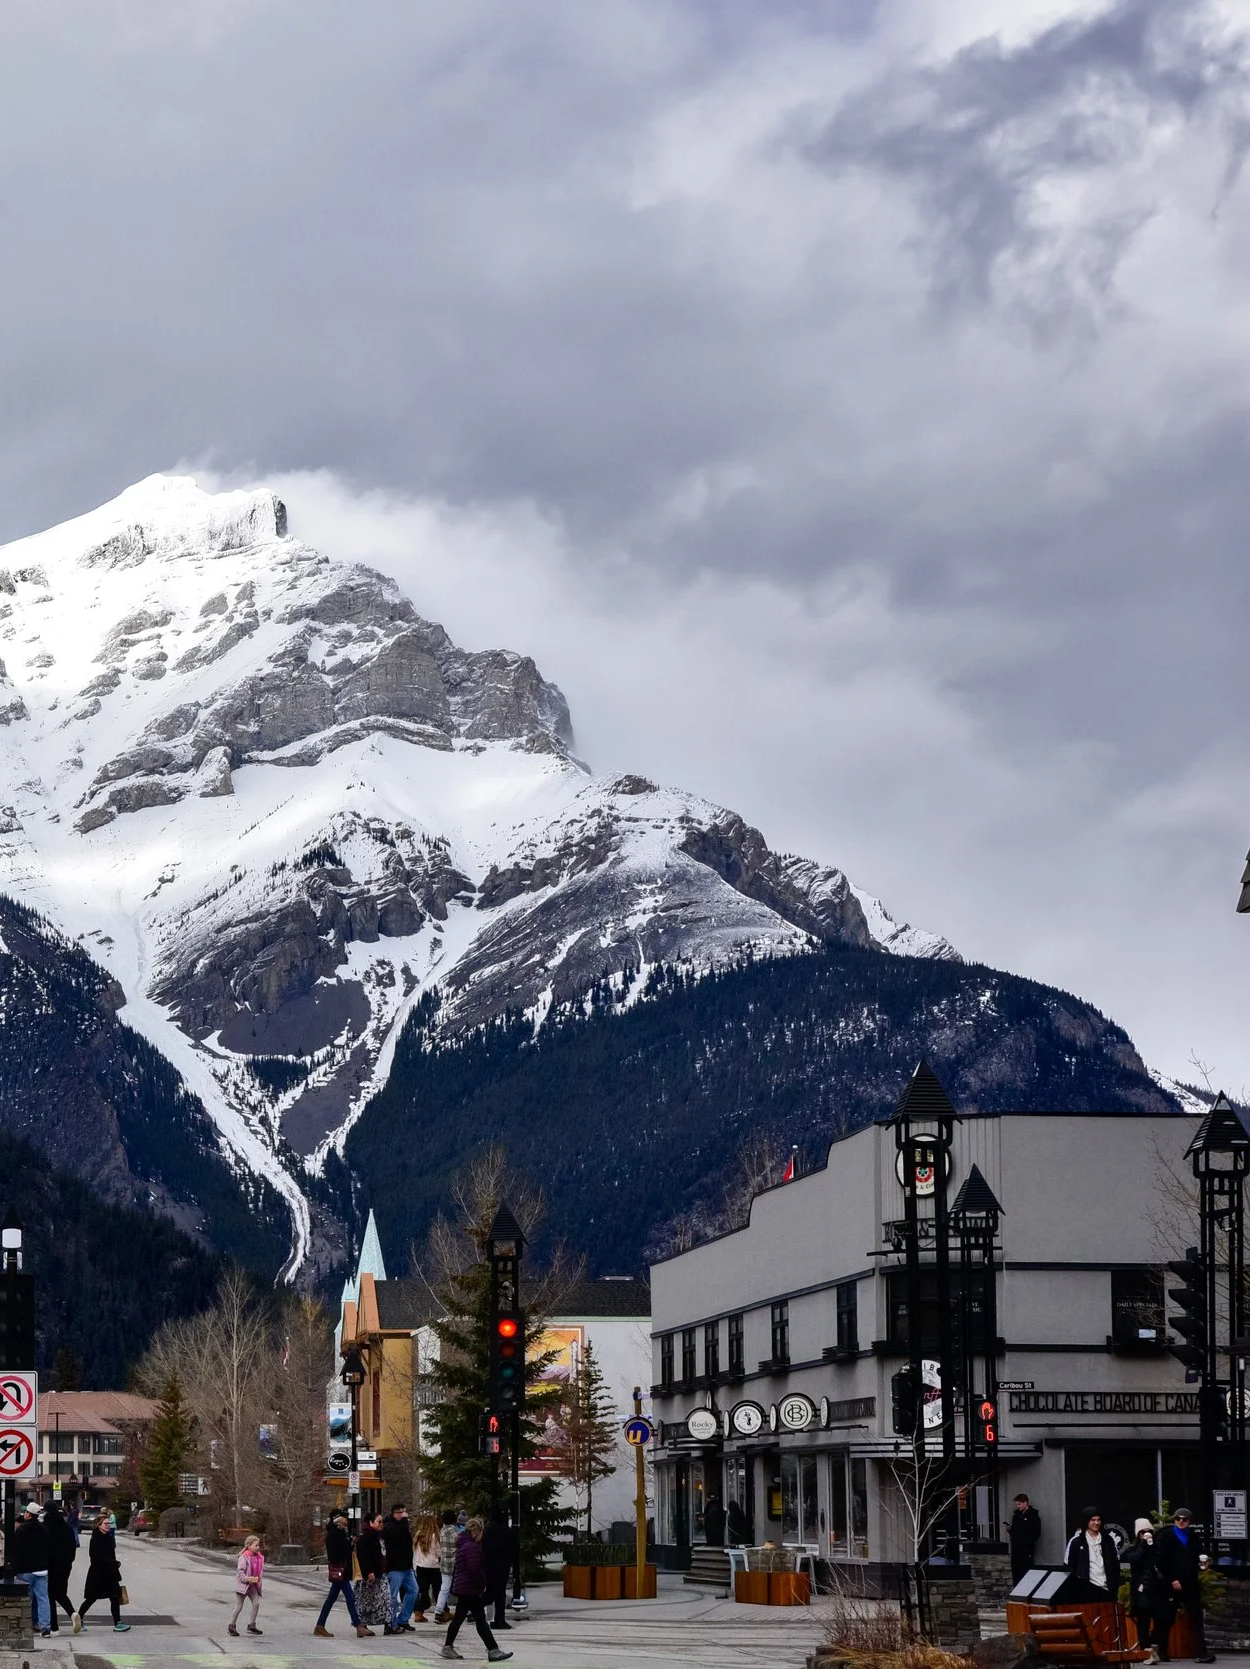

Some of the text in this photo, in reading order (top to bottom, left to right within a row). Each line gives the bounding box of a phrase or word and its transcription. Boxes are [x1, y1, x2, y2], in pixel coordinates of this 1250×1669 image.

[1010, 1392, 1201, 1412] CHOCOLATE BOARD OF CANA
[691, 1421, 713, 1429] Rocky
[986, 1424, 994, 1441] 6
